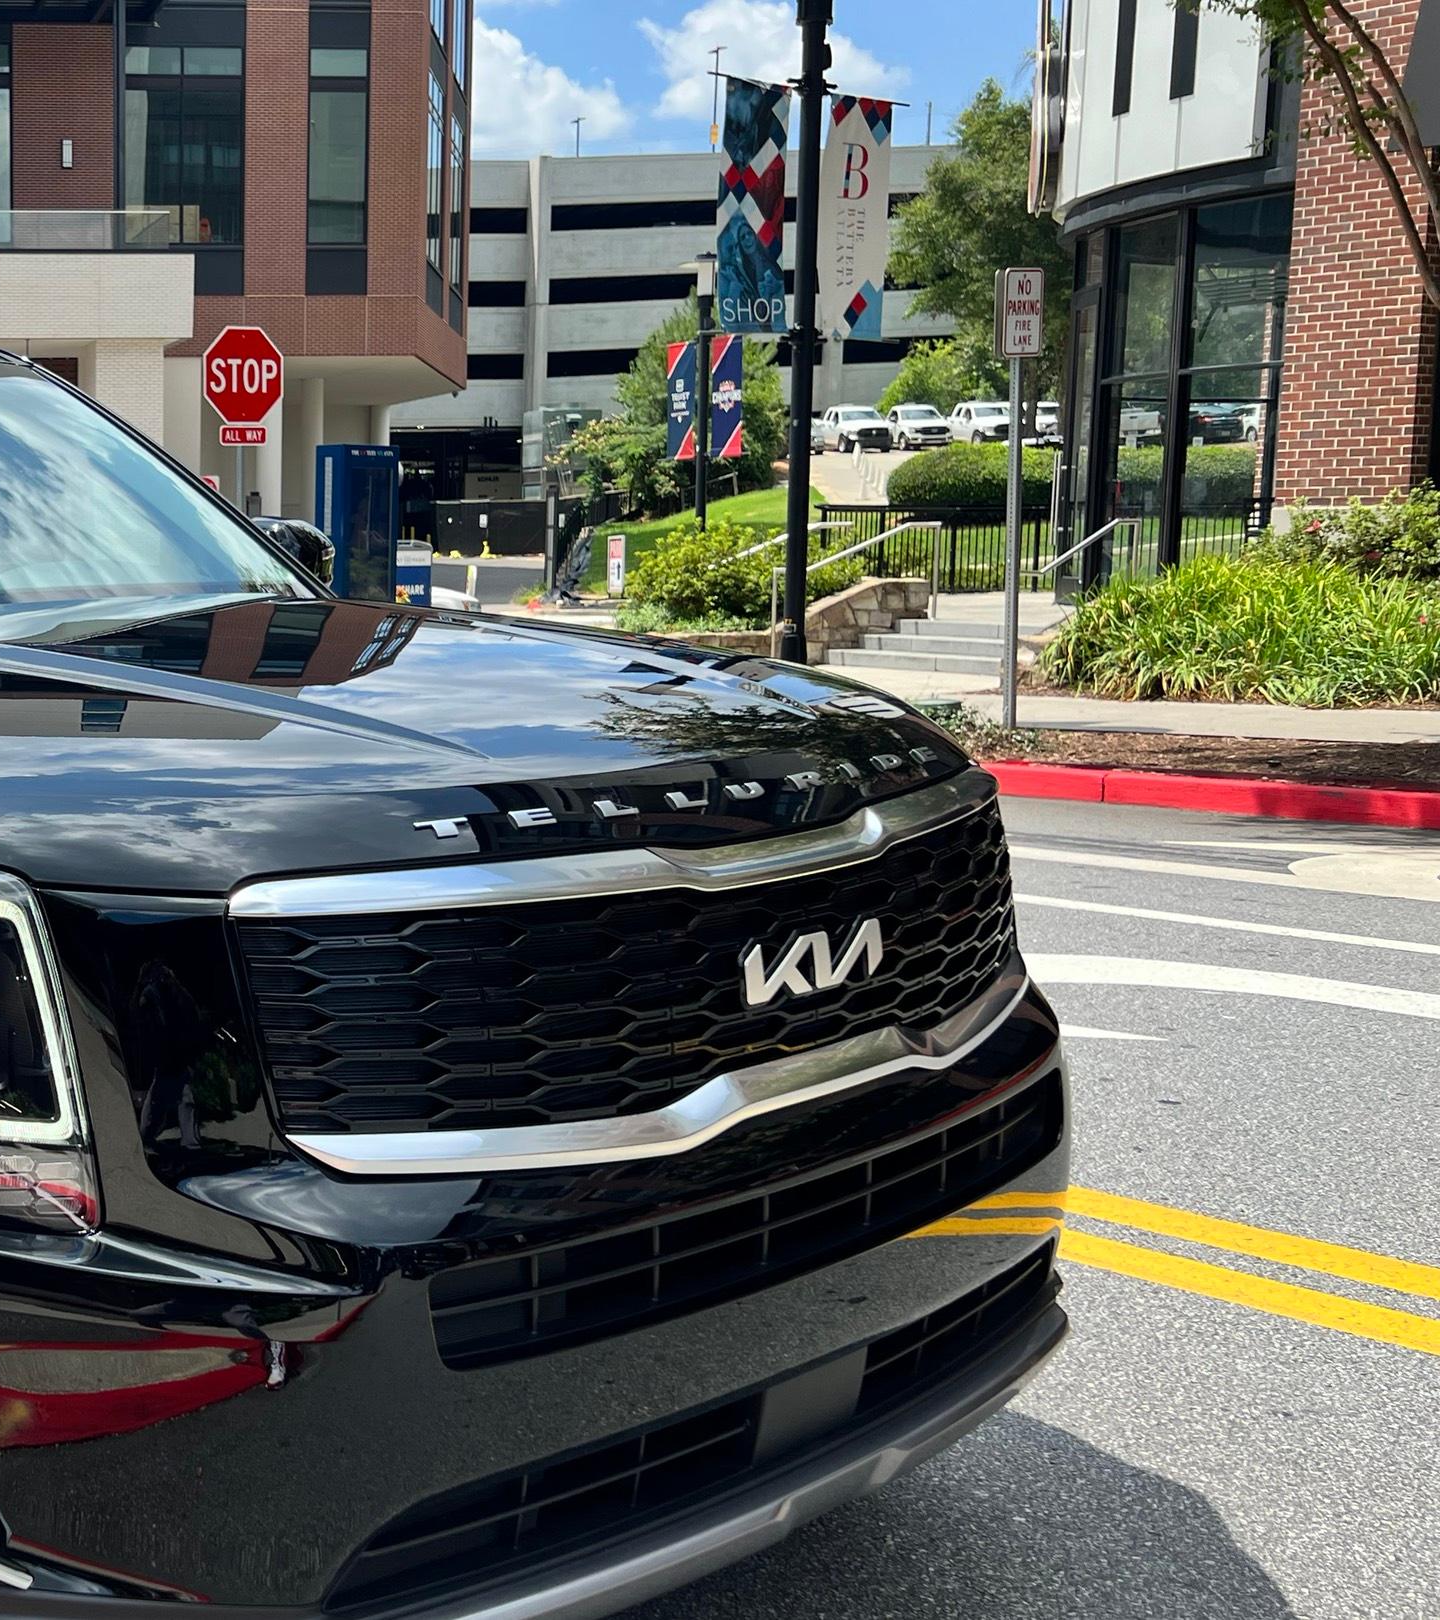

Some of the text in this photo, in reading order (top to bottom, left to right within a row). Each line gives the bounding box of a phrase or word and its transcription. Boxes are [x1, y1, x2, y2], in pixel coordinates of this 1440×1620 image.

[837, 142, 869, 200] B
[856, 208, 866, 242] THE
[836, 209, 846, 287] ATLANTA
[846, 208, 857, 286] BATTERY
[1017, 279, 1032, 295] NO
[722, 297, 783, 322] SHOP
[1007, 300, 1040, 316] PARKING
[1013, 335, 1032, 346] LANE
[1014, 320, 1032, 331] FIRE
[209, 357, 278, 394] STOP
[224, 430, 263, 442] ALL WAY
[413, 747, 938, 839] TELLURIDE
[743, 917, 884, 1005] KIA
